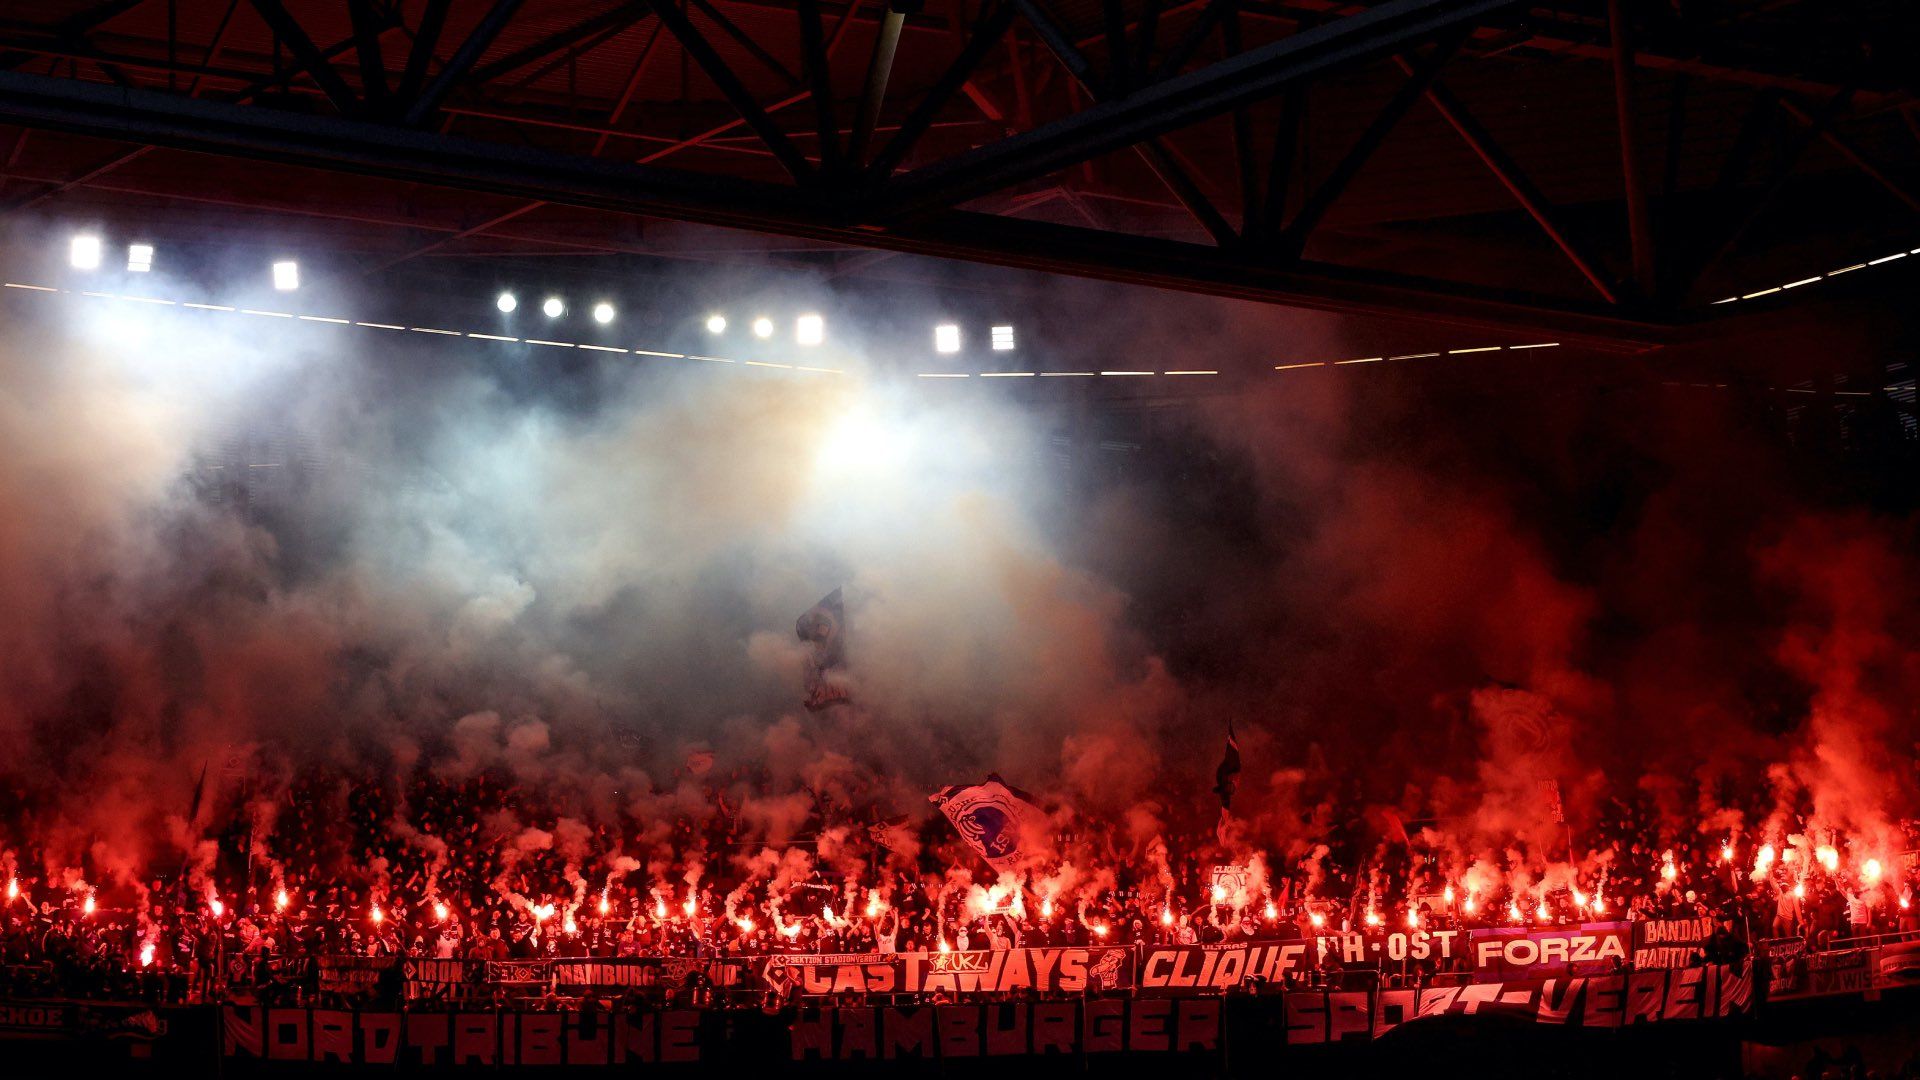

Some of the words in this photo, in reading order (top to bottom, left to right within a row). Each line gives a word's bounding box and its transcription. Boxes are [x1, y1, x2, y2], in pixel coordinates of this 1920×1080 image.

[790, 956, 822, 964] SEKTION
[825, 954, 882, 964] STADIONVERBOT
[1201, 942, 1248, 950] ULTRAS
[1478, 935, 1625, 967] FORZA
[418, 960, 463, 983] IRON
[803, 949, 1089, 993] CASTAWAYS
[1143, 944, 1305, 989] CLIQUE
[790, 1000, 1220, 1060] HAMBURGER
